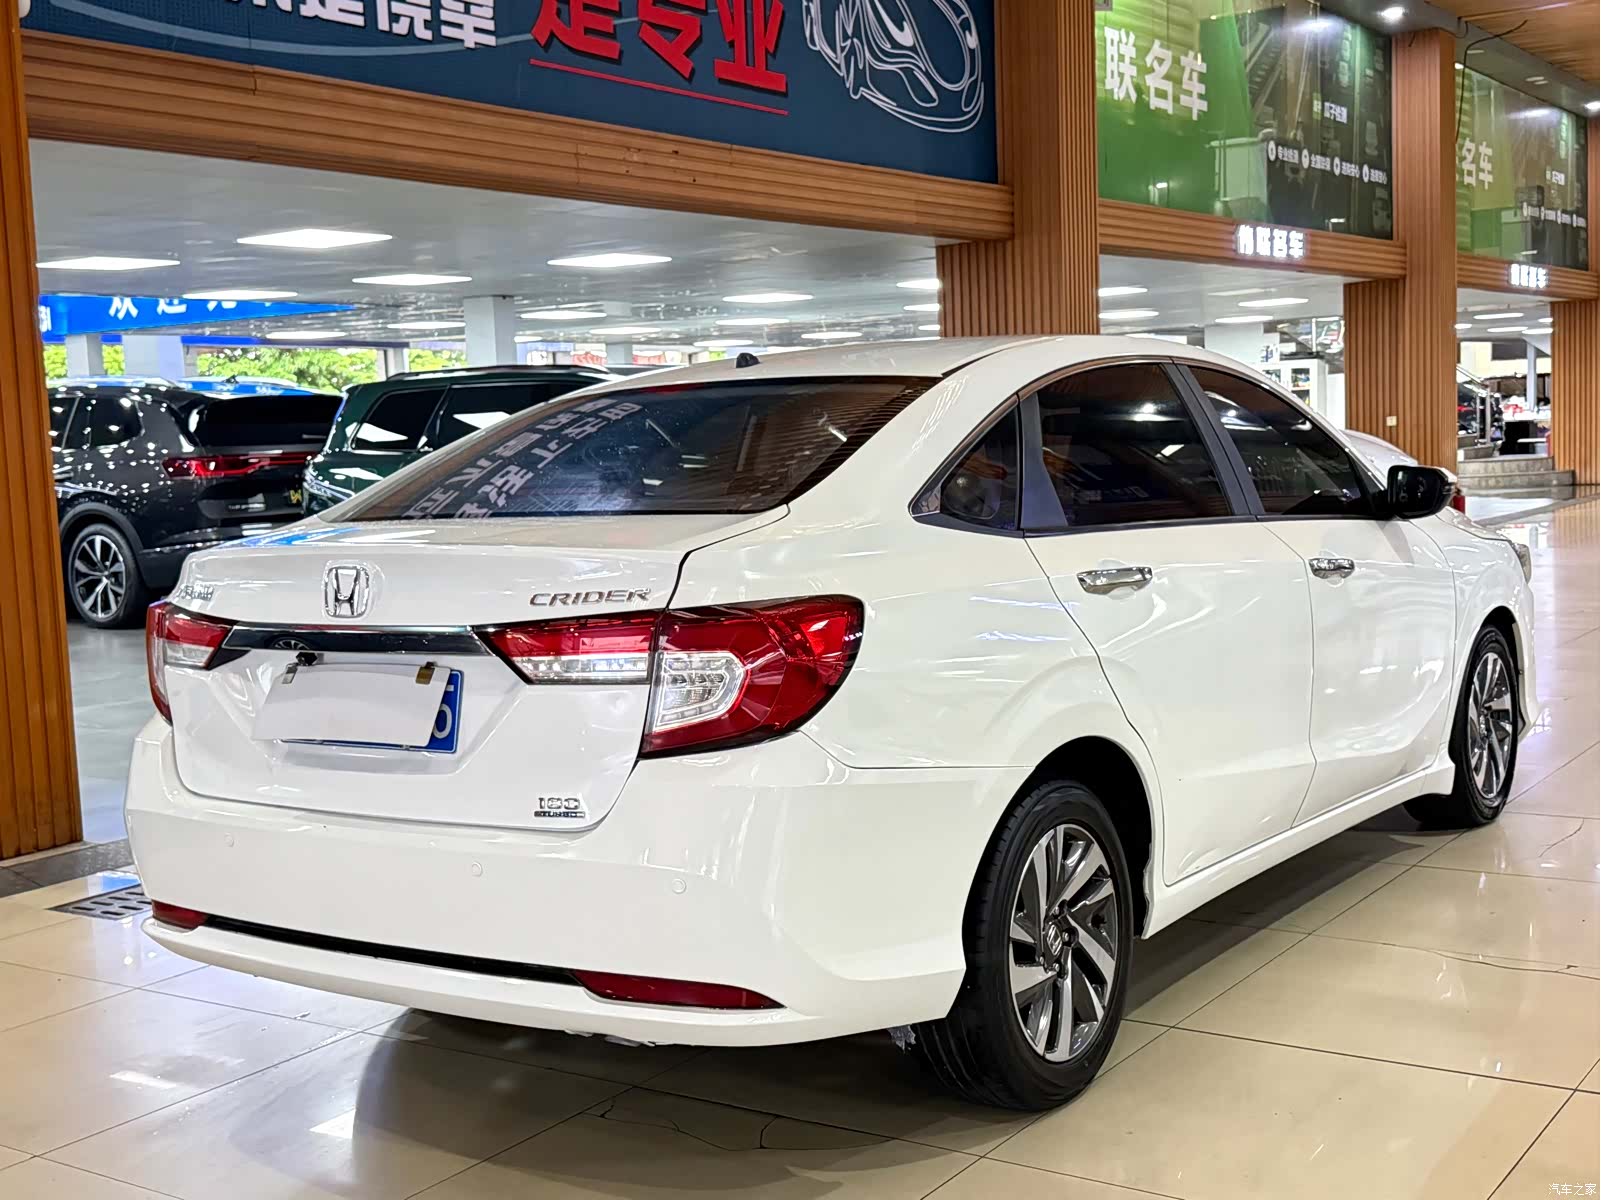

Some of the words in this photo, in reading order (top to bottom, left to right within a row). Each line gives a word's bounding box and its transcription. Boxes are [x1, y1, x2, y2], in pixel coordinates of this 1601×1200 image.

[1104, 26, 1207, 120] 联名车
[1456, 137, 1493, 190] 名车
[529, 587, 651, 606] CRIDER
